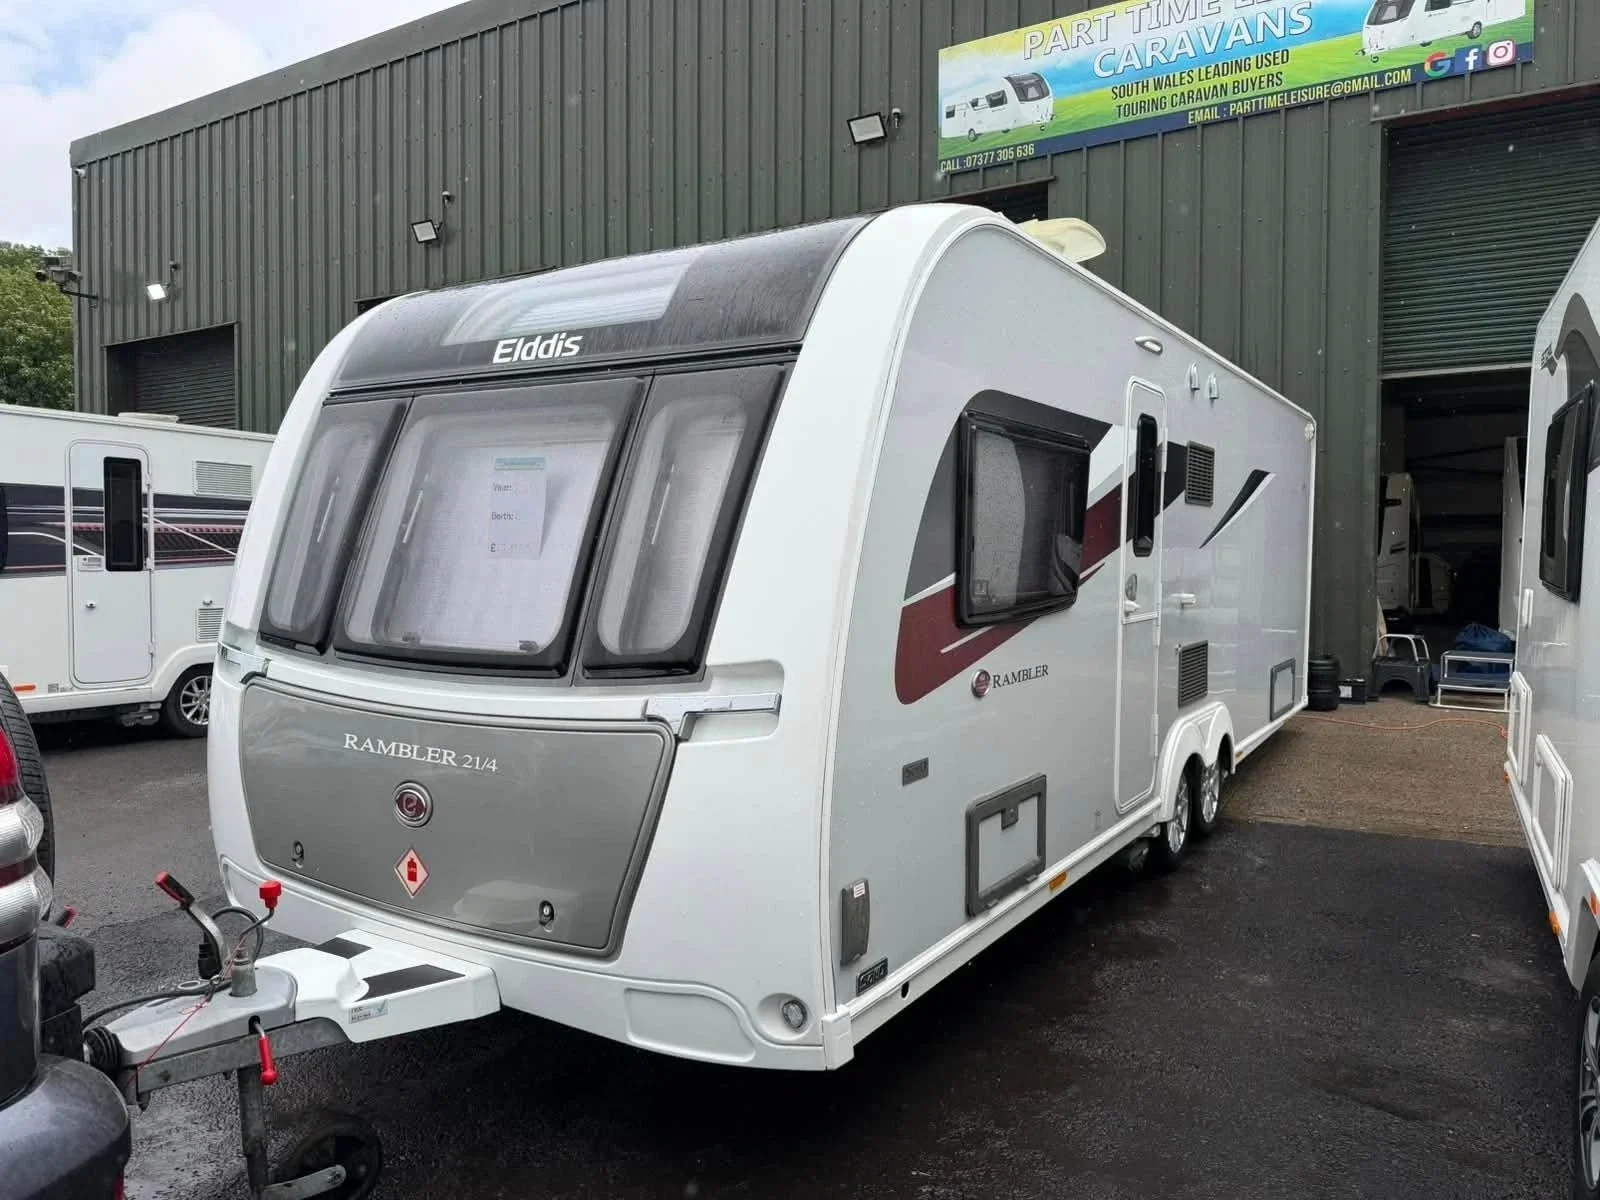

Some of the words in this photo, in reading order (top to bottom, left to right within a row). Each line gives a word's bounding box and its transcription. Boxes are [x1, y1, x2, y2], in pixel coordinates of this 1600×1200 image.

[1023, 9, 1116, 60] PART
[1093, 1, 1312, 78] CARAVANS
[1112, 79, 1149, 100] SOUTH
[1153, 69, 1194, 91] WALES
[1198, 57, 1251, 83] LEADING
[1255, 49, 1290, 70] USED
[1116, 96, 1168, 119] TOURING
[1170, 83, 1231, 108] CARAVAN
[1233, 71, 1283, 95] BUYERS
[1188, 107, 1221, 124] EMAIL
[1229, 68, 1412, 116] PARTTIMELEISURE@GMAIL.COM
[996, 147, 1015, 161] 305
[1016, 143, 1035, 158] 636
[492, 332, 583, 364] Elddis
[992, 664, 1049, 689] RAMBLER
[343, 732, 458, 767] RAMBLER
[461, 754, 499, 773] 21/4
